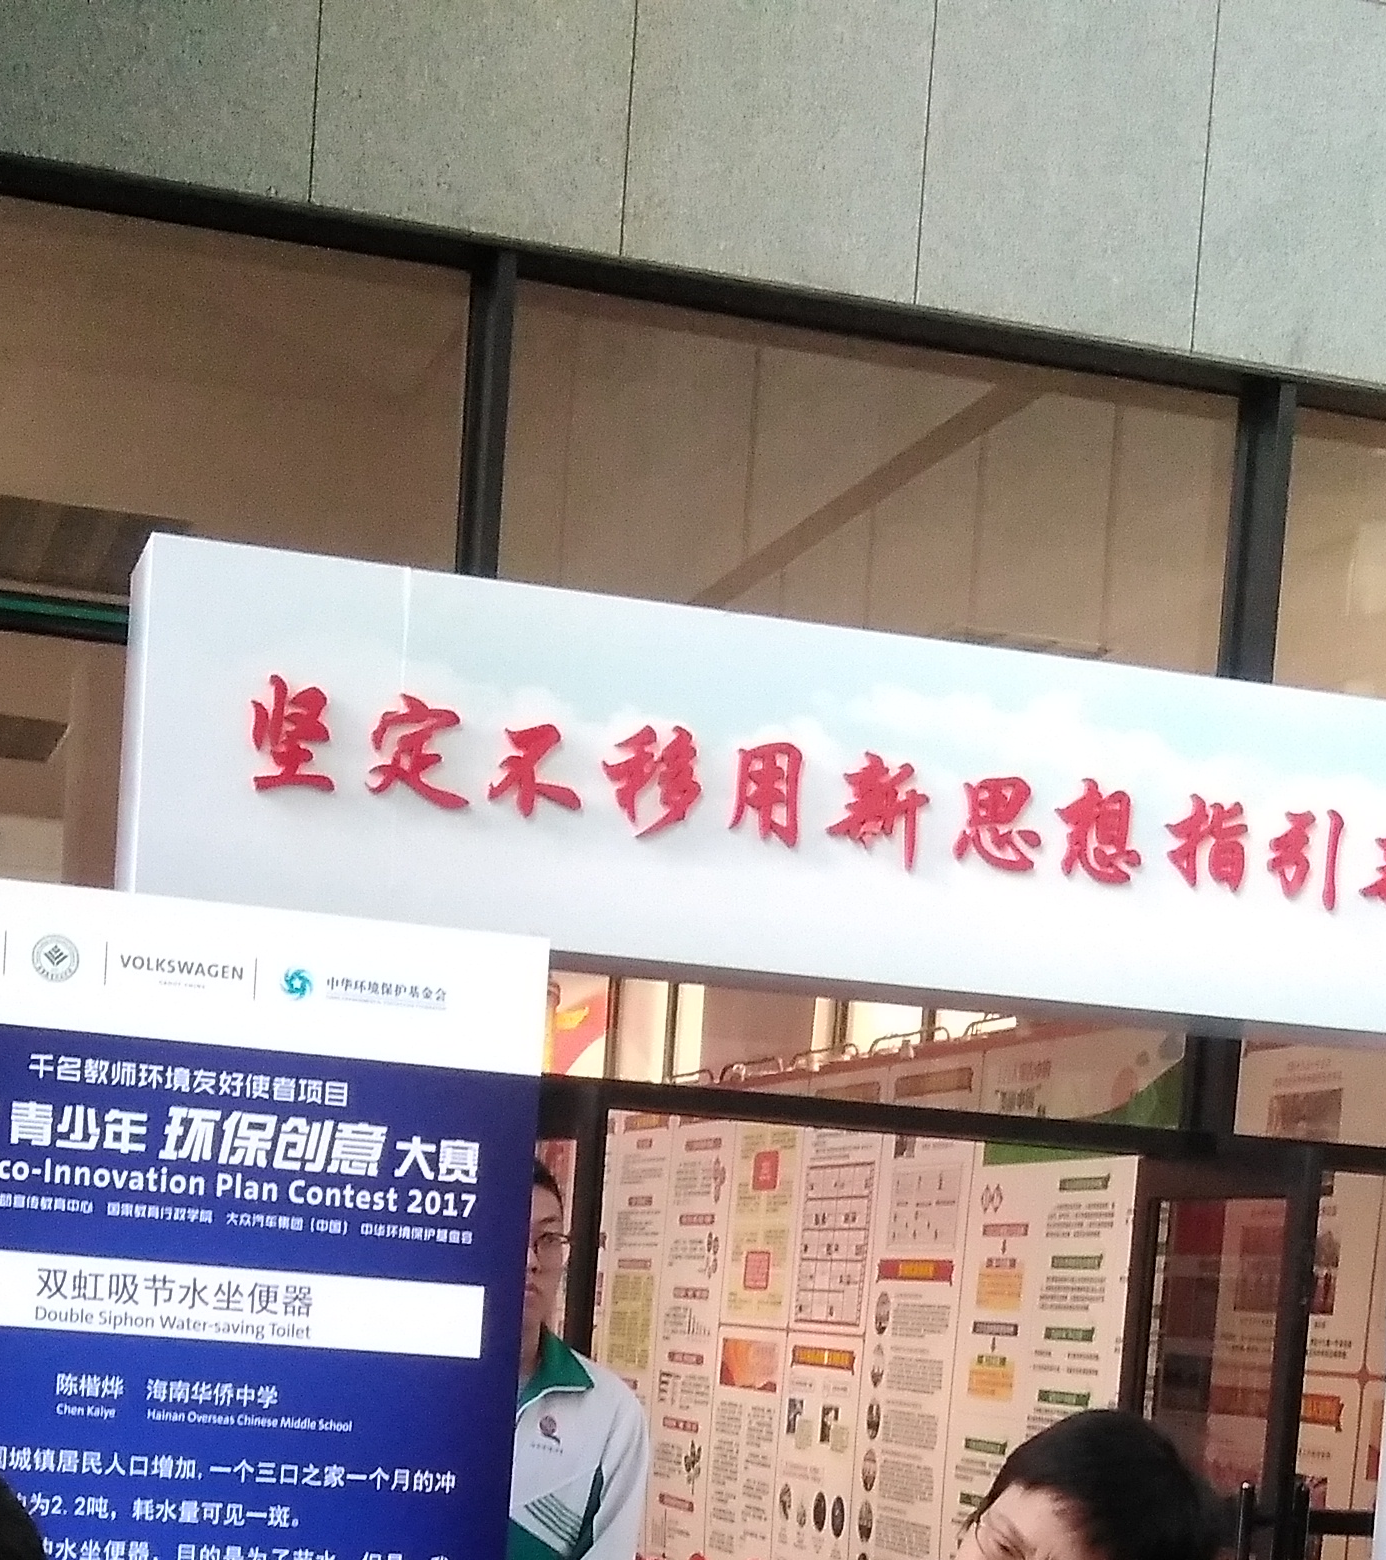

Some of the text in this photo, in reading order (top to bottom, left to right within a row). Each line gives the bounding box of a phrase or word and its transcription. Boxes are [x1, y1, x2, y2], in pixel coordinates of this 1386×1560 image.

[119, 953, 244, 981] VOLKSWAGEN
[326, 976, 447, 1003] 中华环境保护基金会
[28, 1054, 349, 1107] 千名教师环境友好使者项目
[9, 1100, 149, 1155] 青少年
[157, 1105, 388, 1179] 环保创意
[393, 1136, 481, 1185] 大赛
[215, 1171, 280, 1204] Plan
[288, 1177, 399, 1213] Contest
[407, 1188, 477, 1219] 2017
[35, 1267, 314, 1319] 双虹吸节水坐便器
[34, 1305, 311, 1341] Double Siphon Water-saving Toilet
[55, 1373, 279, 1409] 陈楷烨 海南华侨中学
[56, 1403, 353, 1433] Chen Kaiye Hainan Overseas Chinese Middle School
[17, 1493, 300, 1529] 为2.2吨，耗水量可见一斑。
